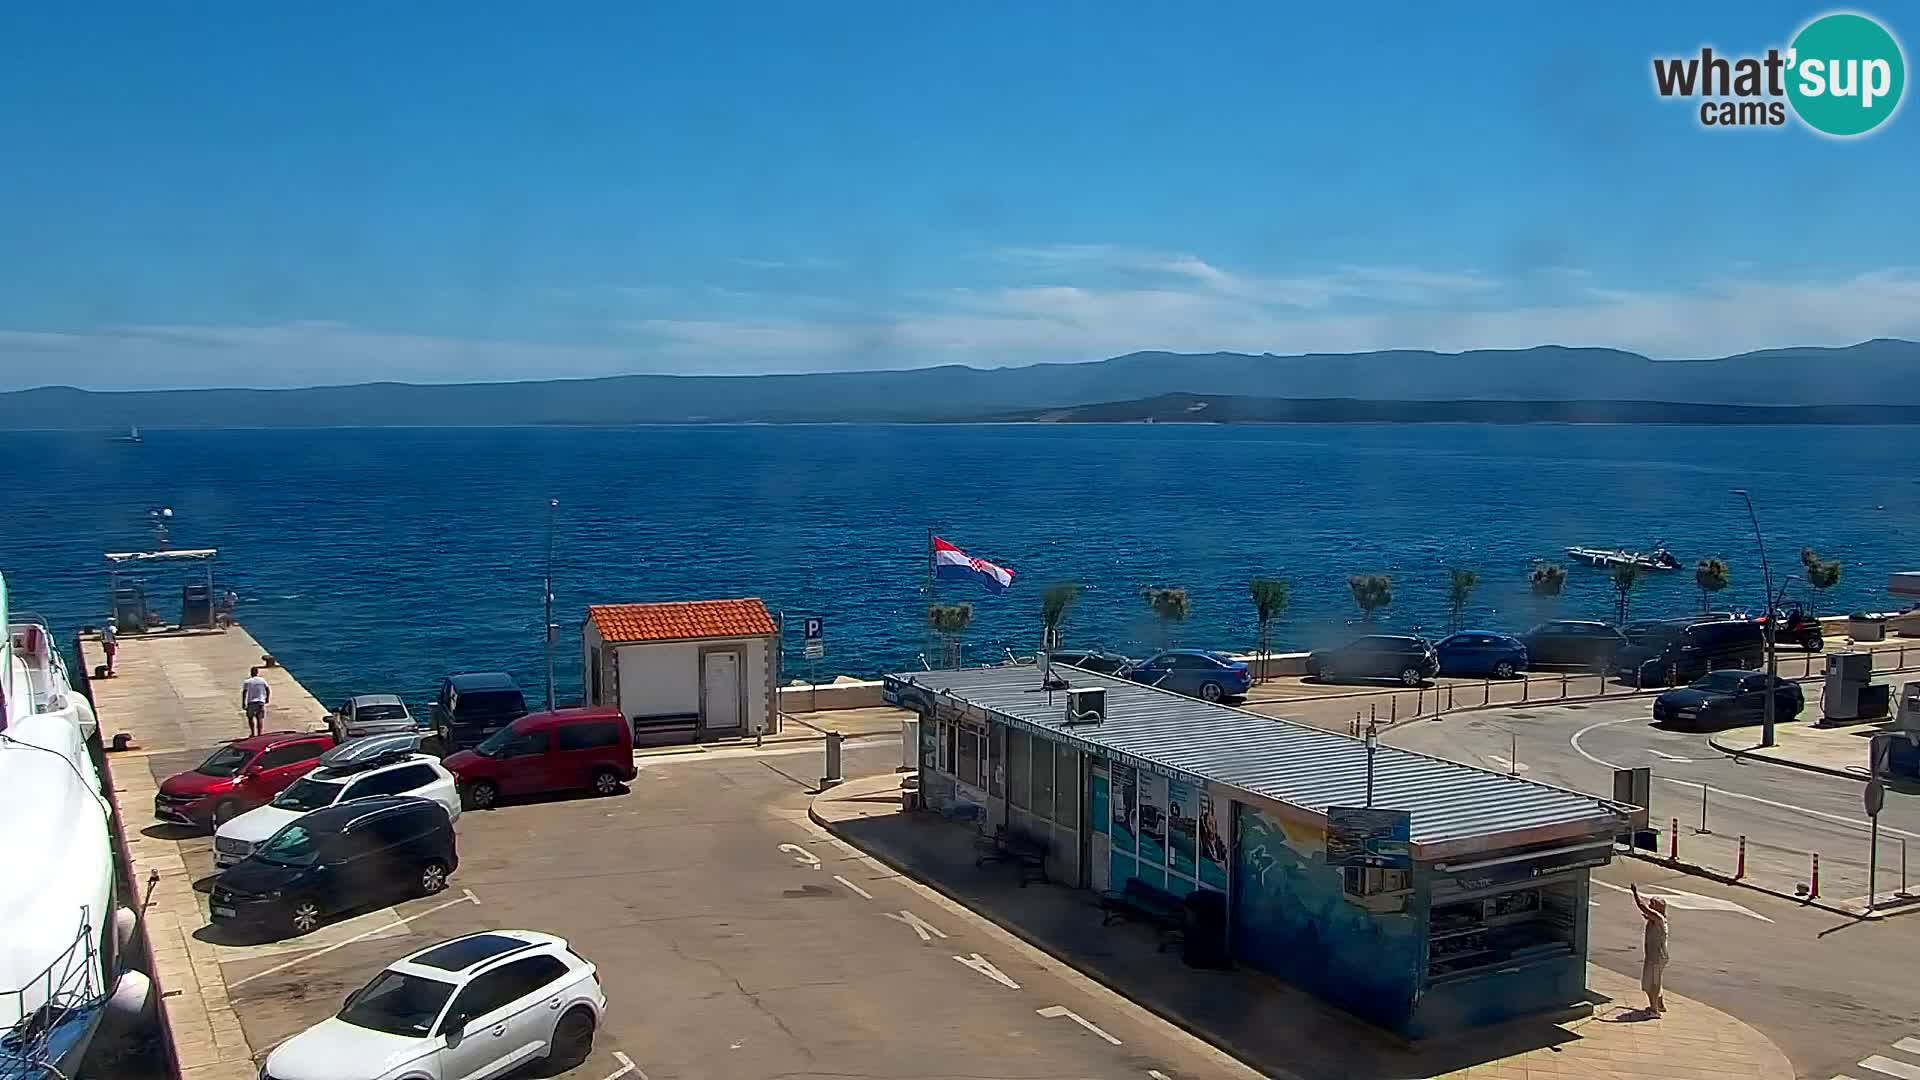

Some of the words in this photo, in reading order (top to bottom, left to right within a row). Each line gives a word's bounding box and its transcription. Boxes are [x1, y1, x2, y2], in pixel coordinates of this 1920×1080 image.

[808, 620, 819, 636] P
[1107, 750, 1120, 762] BUS
[1122, 755, 1152, 772] STATION
[1154, 764, 1178, 780] TICKET
